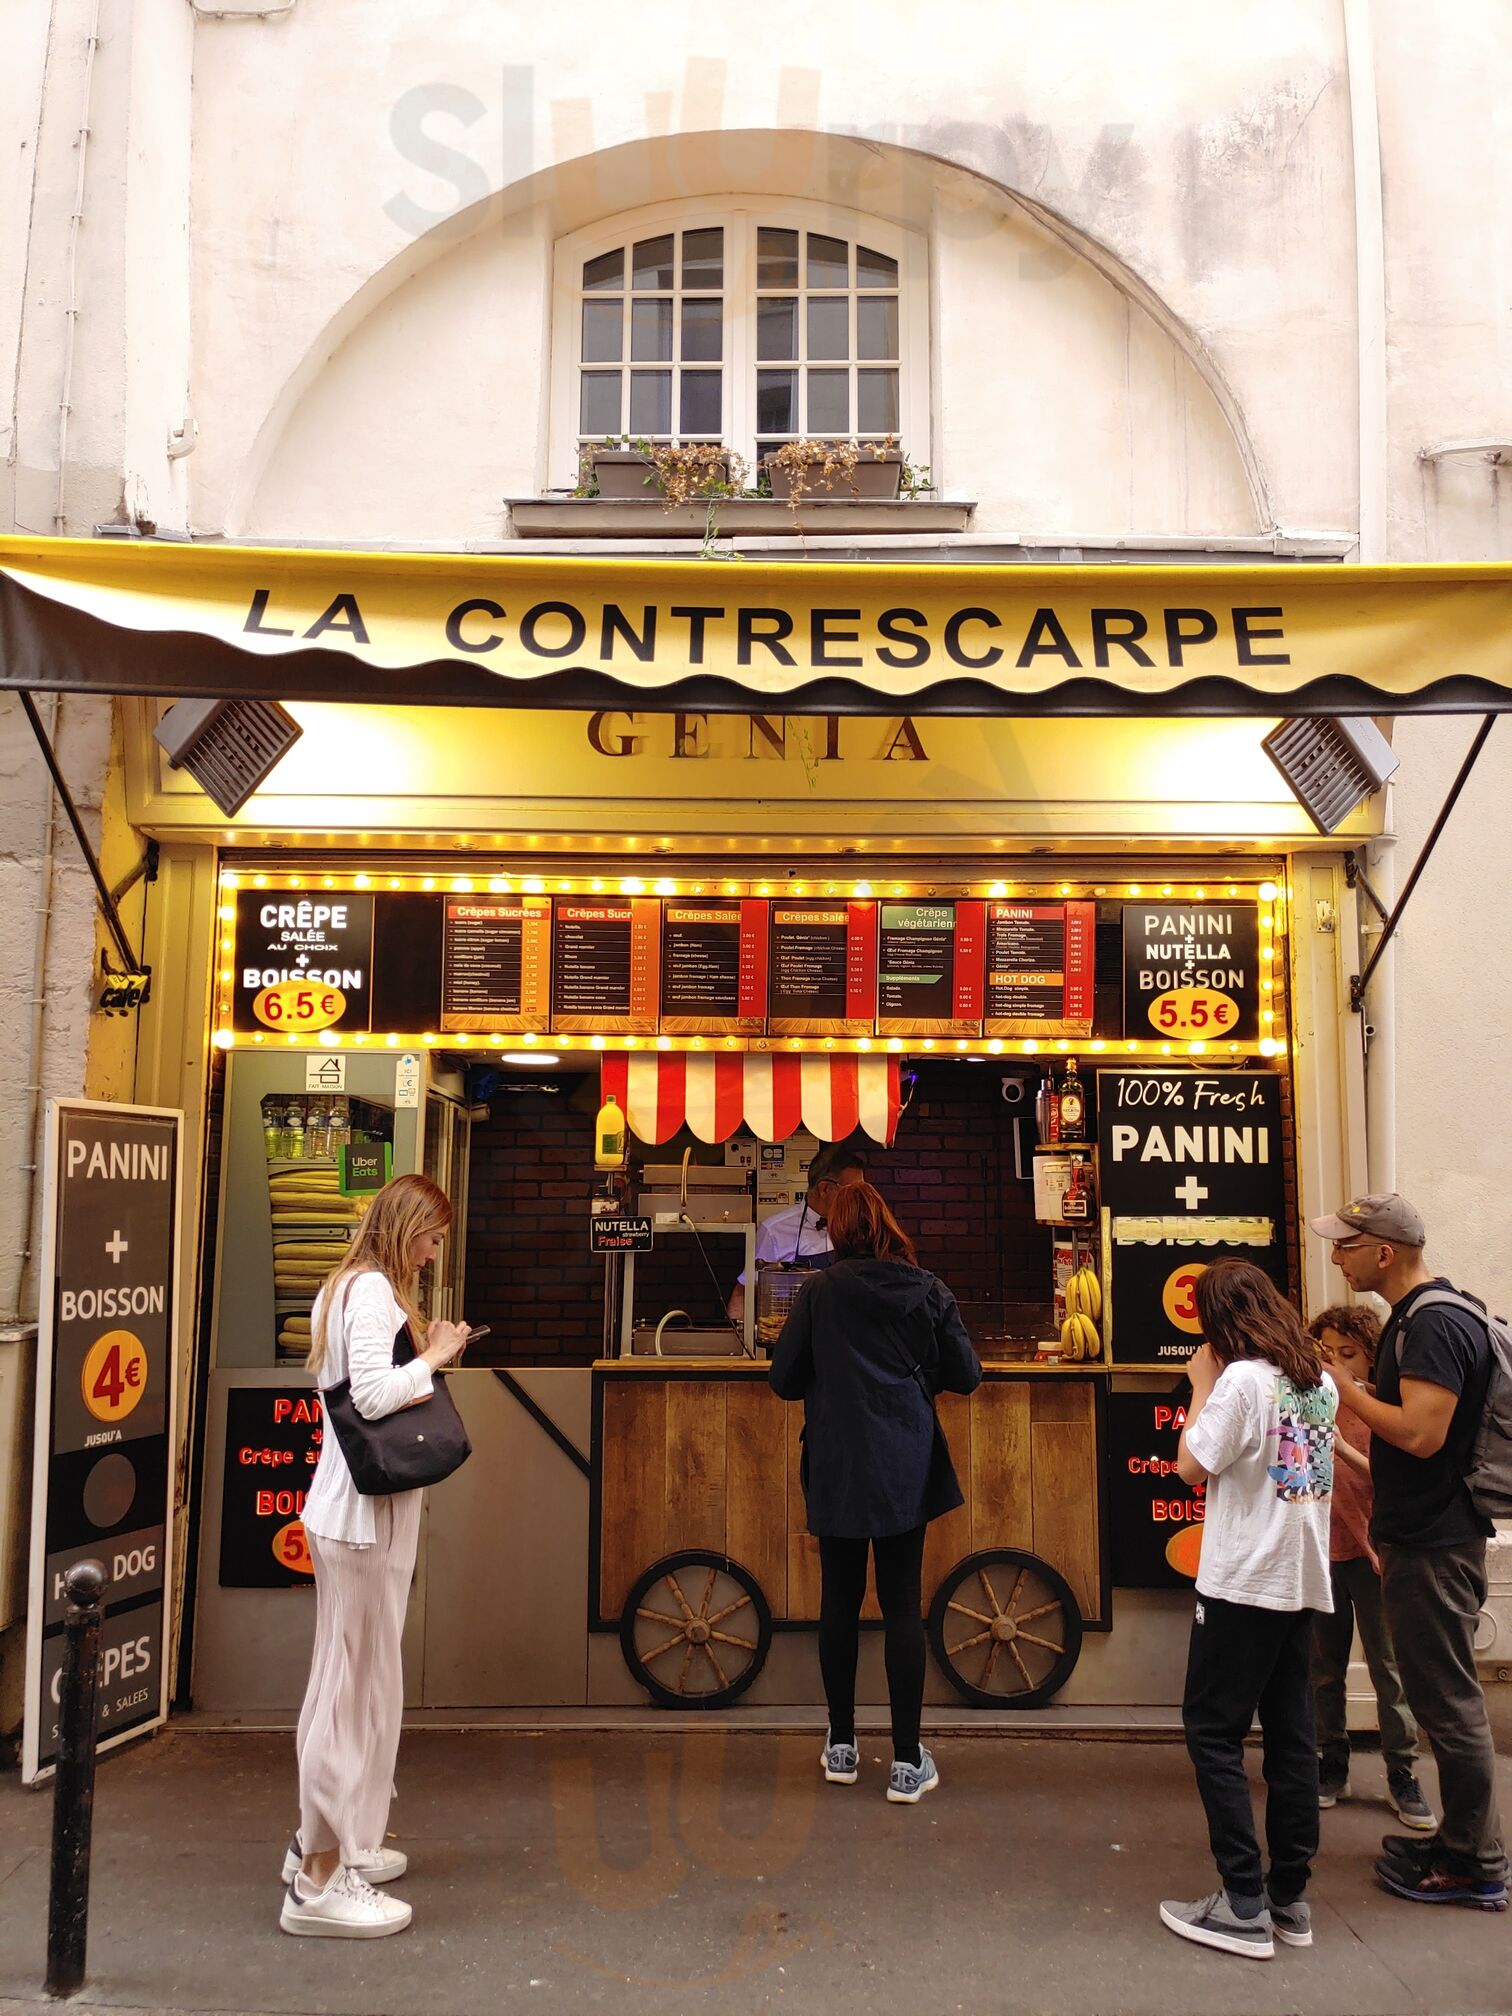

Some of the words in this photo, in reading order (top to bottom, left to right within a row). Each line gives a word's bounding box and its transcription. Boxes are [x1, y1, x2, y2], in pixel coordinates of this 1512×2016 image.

[242, 589, 371, 645] LA
[446, 598, 1291, 669] CONTRESCARPE
[260, 901, 347, 929] CRÊPE
[457, 907, 496, 917] Crêpes
[498, 908, 541, 917] Sucrées
[567, 909, 605, 919] Crêpes
[675, 911, 712, 920] Crêpes
[783, 913, 820, 923] Crêpes
[916, 908, 947, 918] Crêpe
[996, 909, 1032, 918] PANINI
[1144, 914, 1232, 935] PANINI
[280, 930, 325, 942] SALÉE
[1146, 944, 1232, 960] NUTELLA
[243, 969, 361, 989] BOISSON
[996, 975, 1018, 983] HOT
[1140, 969, 1244, 990] BOISSON
[1117, 1078, 1184, 1107] 100%
[1194, 1080, 1264, 1112] Fresh
[1112, 1125, 1268, 1164] PANINI
[67, 1139, 168, 1181] PANINI
[352, 1157, 378, 1166] Uber
[352, 1168, 378, 1177] Eats
[595, 1221, 648, 1231] NUTELLA
[598, 1236, 633, 1246] Fraise
[62, 1286, 164, 1322] BOISSON
[240, 1447, 294, 1468] Crêpe
[114, 1546, 155, 1582] DOG
